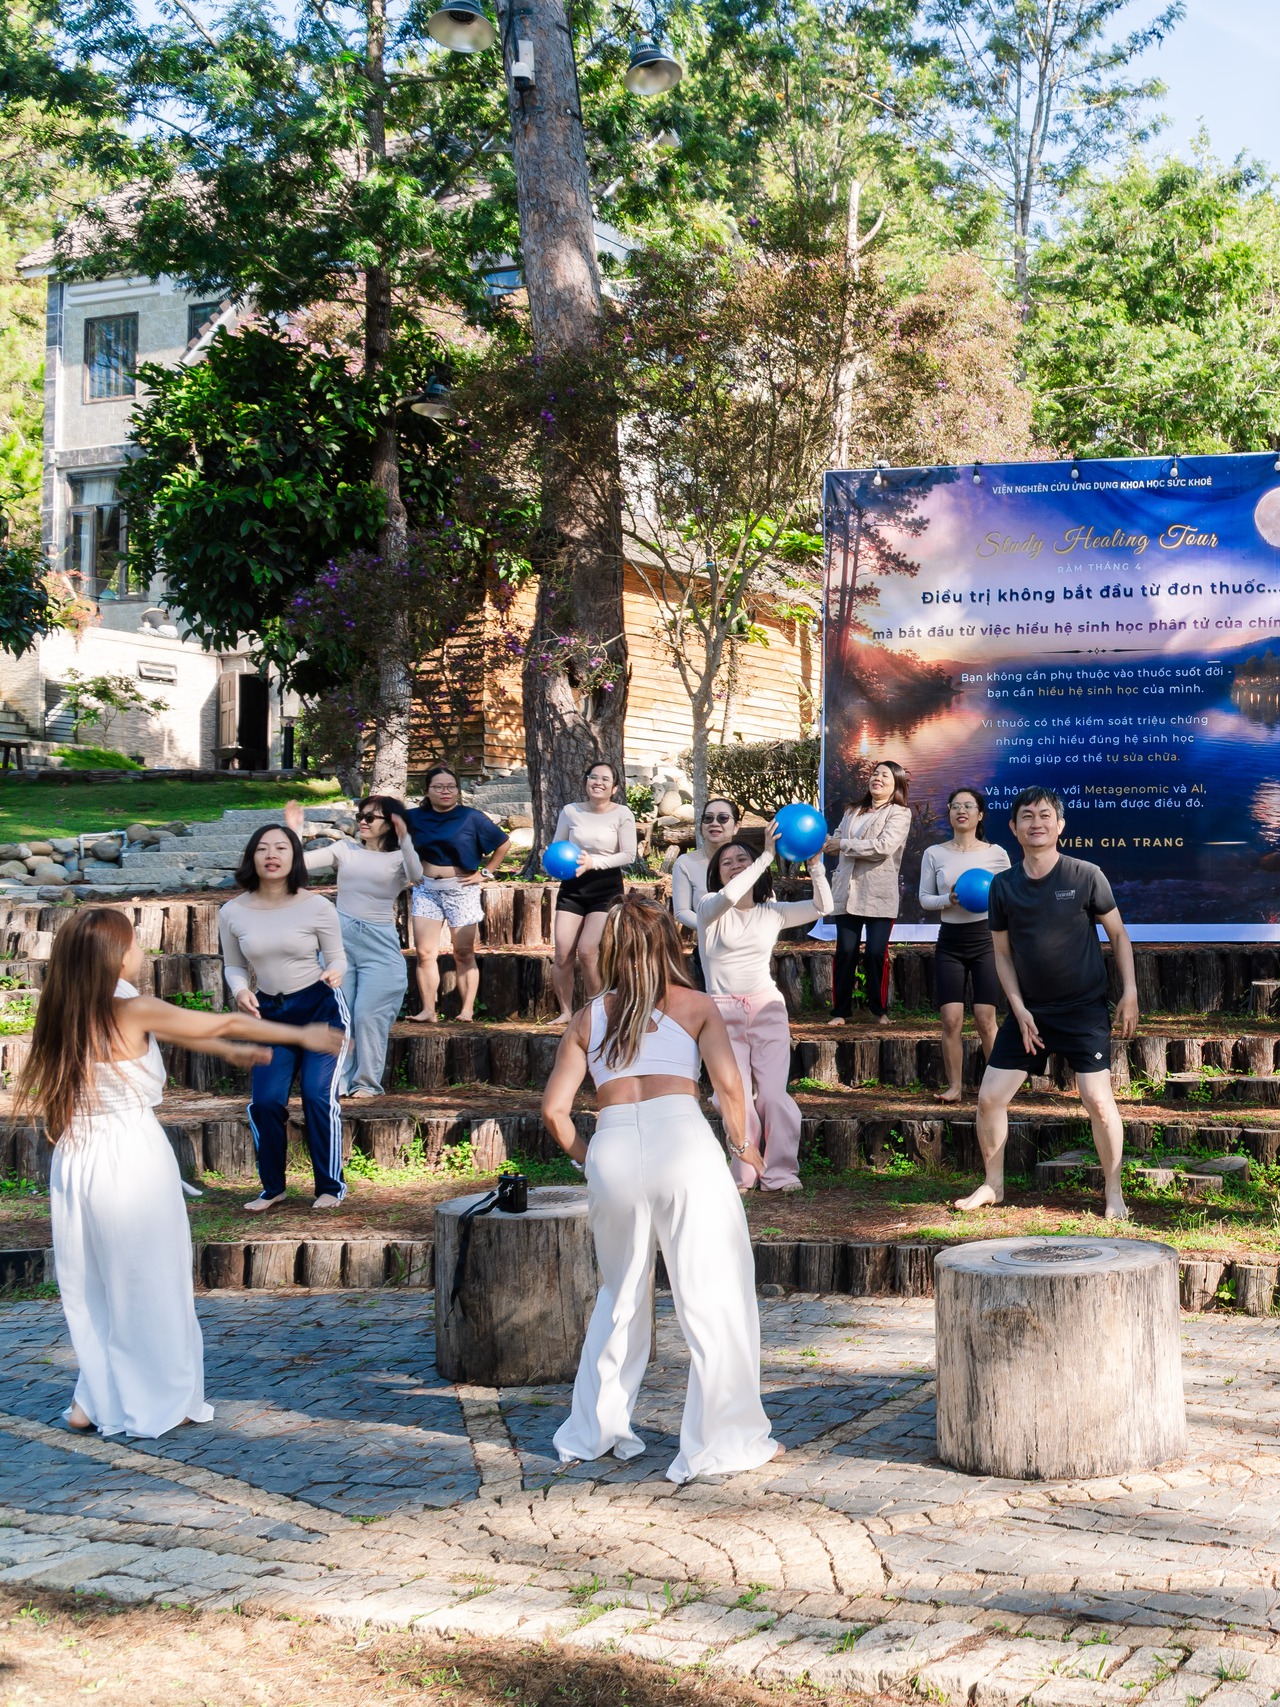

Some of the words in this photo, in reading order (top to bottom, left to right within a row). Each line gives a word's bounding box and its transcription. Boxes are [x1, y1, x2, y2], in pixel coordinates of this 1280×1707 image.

[992, 484, 1013, 495] VIỆN
[1015, 483, 1049, 494] NGHIÊN
[1050, 481, 1070, 492] CỨU
[1071, 480, 1092, 491] ỨNG
[1093, 481, 1119, 492] DỤNG
[1120, 480, 1145, 490] KHOA
[1147, 479, 1165, 490] HỌC
[1167, 477, 1186, 487] SỨC
[976, 531, 1044, 560] Study
[1053, 525, 1150, 555] Healing
[1158, 523, 1219, 550] Tour
[1088, 561, 1129, 571] THÁNG
[921, 588, 963, 605] Điều
[969, 589, 991, 606] trị
[998, 588, 1055, 603] không
[1063, 584, 1093, 600] bắt
[1099, 583, 1133, 599] đầu
[1141, 583, 1160, 597] từ
[1168, 582, 1203, 596] đơn
[872, 627, 893, 640] mà
[899, 625, 922, 639] bắt
[959, 624, 975, 637] từ
[980, 623, 1011, 638] việc
[1016, 621, 1049, 635] hiểu
[1054, 622, 1073, 636] hệ
[1077, 620, 1110, 633] sinh
[1115, 620, 1143, 634] học
[1148, 618, 1187, 633] phân
[1192, 617, 1209, 629] tử
[1215, 616, 1243, 629] của
[961, 673, 983, 683] Bạn
[986, 671, 1022, 682] không
[1050, 670, 1073, 681] phụ
[1077, 669, 1110, 680] thuộc
[1113, 668, 1134, 678] vào
[1137, 667, 1172, 677] thuốc
[1175, 666, 1201, 677] suốt
[1205, 667, 1224, 676] đời
[987, 688, 1009, 699] bạn
[1068, 686, 1083, 697] hệ
[1087, 685, 1113, 695] sinh
[1117, 685, 1139, 696] học
[1143, 684, 1164, 694] của
[1169, 683, 1204, 693] mình.
[981, 719, 993, 728] Vì
[997, 718, 1030, 728] thuốc
[1034, 718, 1047, 727] có
[1108, 716, 1133, 725] soát
[1137, 716, 1166, 726] triệu
[1170, 715, 1208, 726] chứng
[996, 737, 1033, 747] nhưng
[1089, 734, 1120, 745] đúng
[1124, 734, 1139, 745] hệ
[1142, 734, 1168, 743] sinh
[1172, 734, 1194, 744] học
[1009, 754, 1031, 763] mới
[1034, 753, 1061, 765] giúp
[1065, 754, 1079, 763] cơ
[1106, 753, 1119, 763] tự
[984, 786, 1000, 796] Và
[1004, 786, 1026, 796] hô
[1062, 785, 1080, 795] với
[1084, 783, 1169, 796] Metagenomic
[1172, 783, 1187, 793] và
[988, 800, 1013, 810] chú
[1094, 798, 1116, 809] làm
[1120, 799, 1151, 810] được
[1185, 798, 1204, 808] đó.
[1058, 836, 1093, 848] VIÊN
[1100, 838, 1127, 848] GIA
[1133, 837, 1184, 847] TRANG
